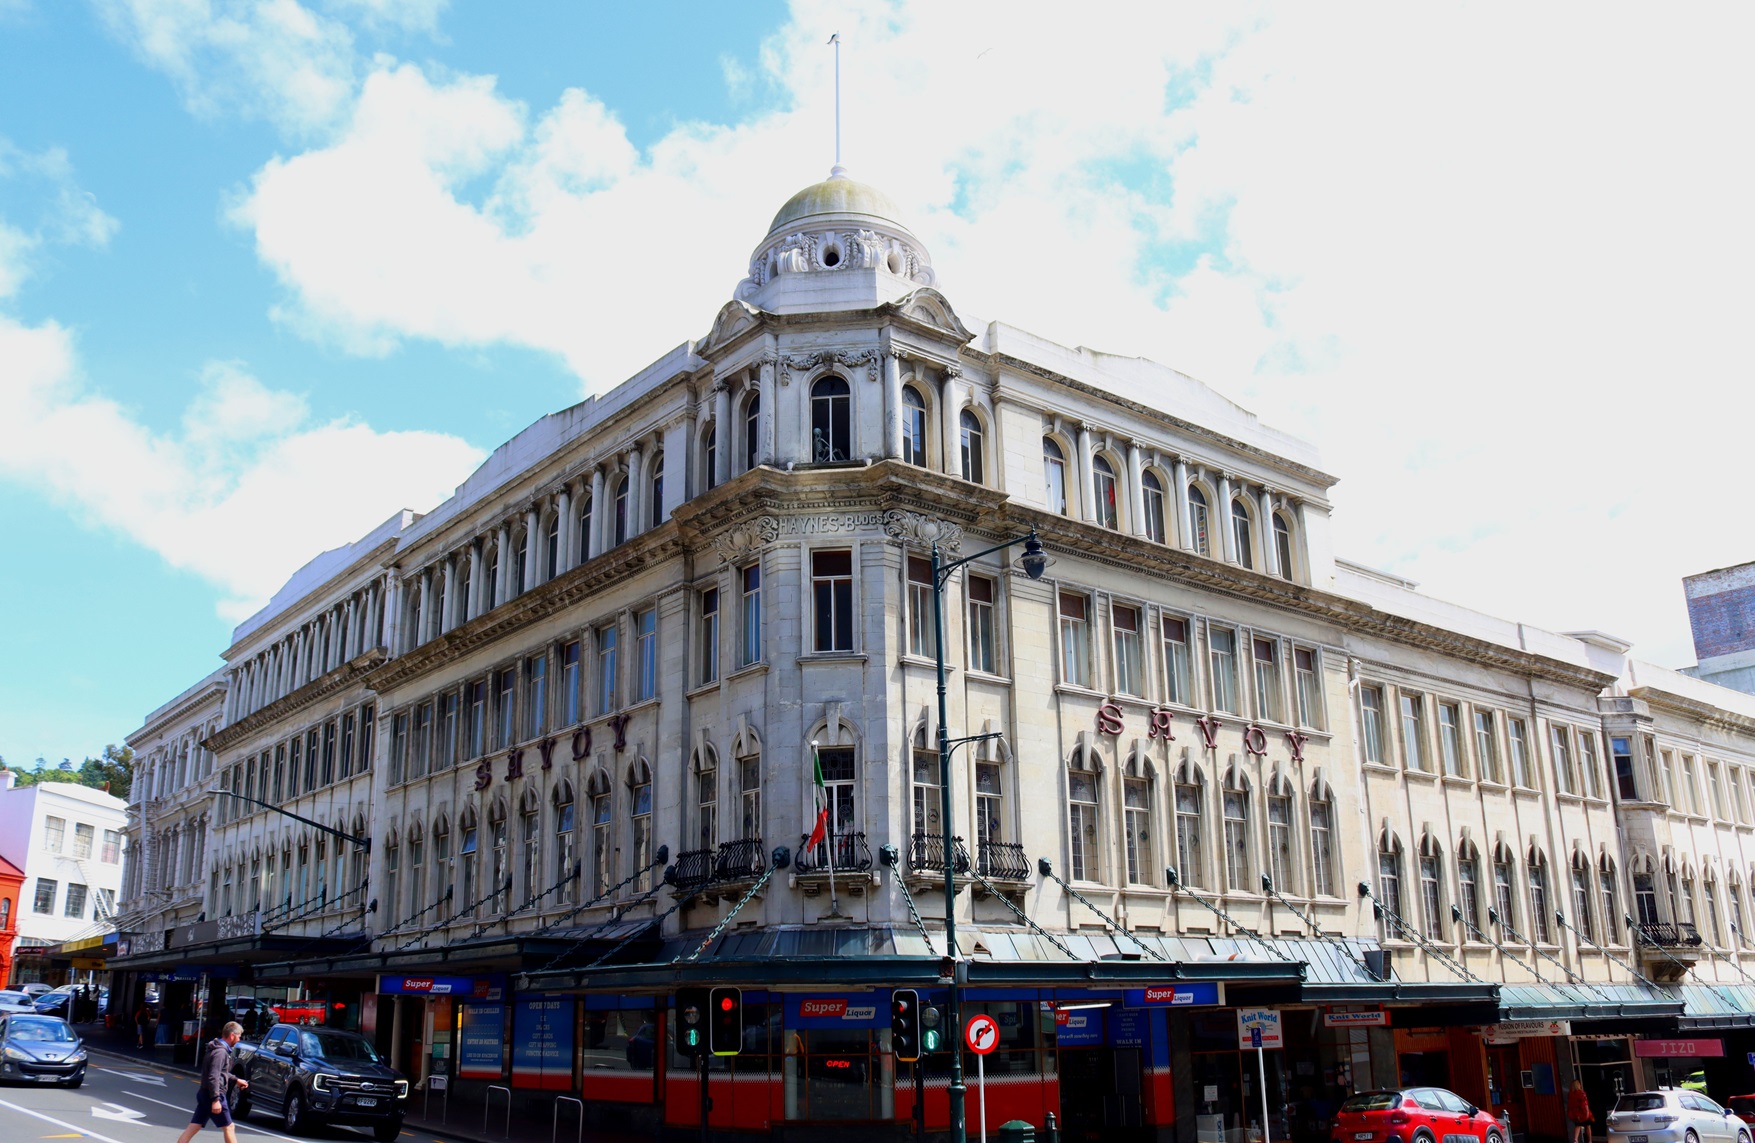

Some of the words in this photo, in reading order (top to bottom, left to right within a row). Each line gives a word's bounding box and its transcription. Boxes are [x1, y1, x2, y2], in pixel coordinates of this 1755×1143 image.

[1098, 703, 1309, 762] SAVOY
[474, 713, 631, 792] SAVOY
[405, 979, 431, 989] Super
[432, 984, 450, 992] Liquor
[1147, 989, 1172, 1001] Super
[528, 1002, 543, 1010] OPEN
[547, 1001, 560, 1009] DAYS
[804, 1001, 843, 1014] Super
[846, 1009, 872, 1018] Liquor
[1241, 1013, 1257, 1024] Knit
[1257, 1011, 1278, 1023] World
[1521, 1021, 1545, 1029] FLAVOURS
[1660, 1042, 1696, 1054] JIZO
[826, 1060, 851, 1068] OPEN
